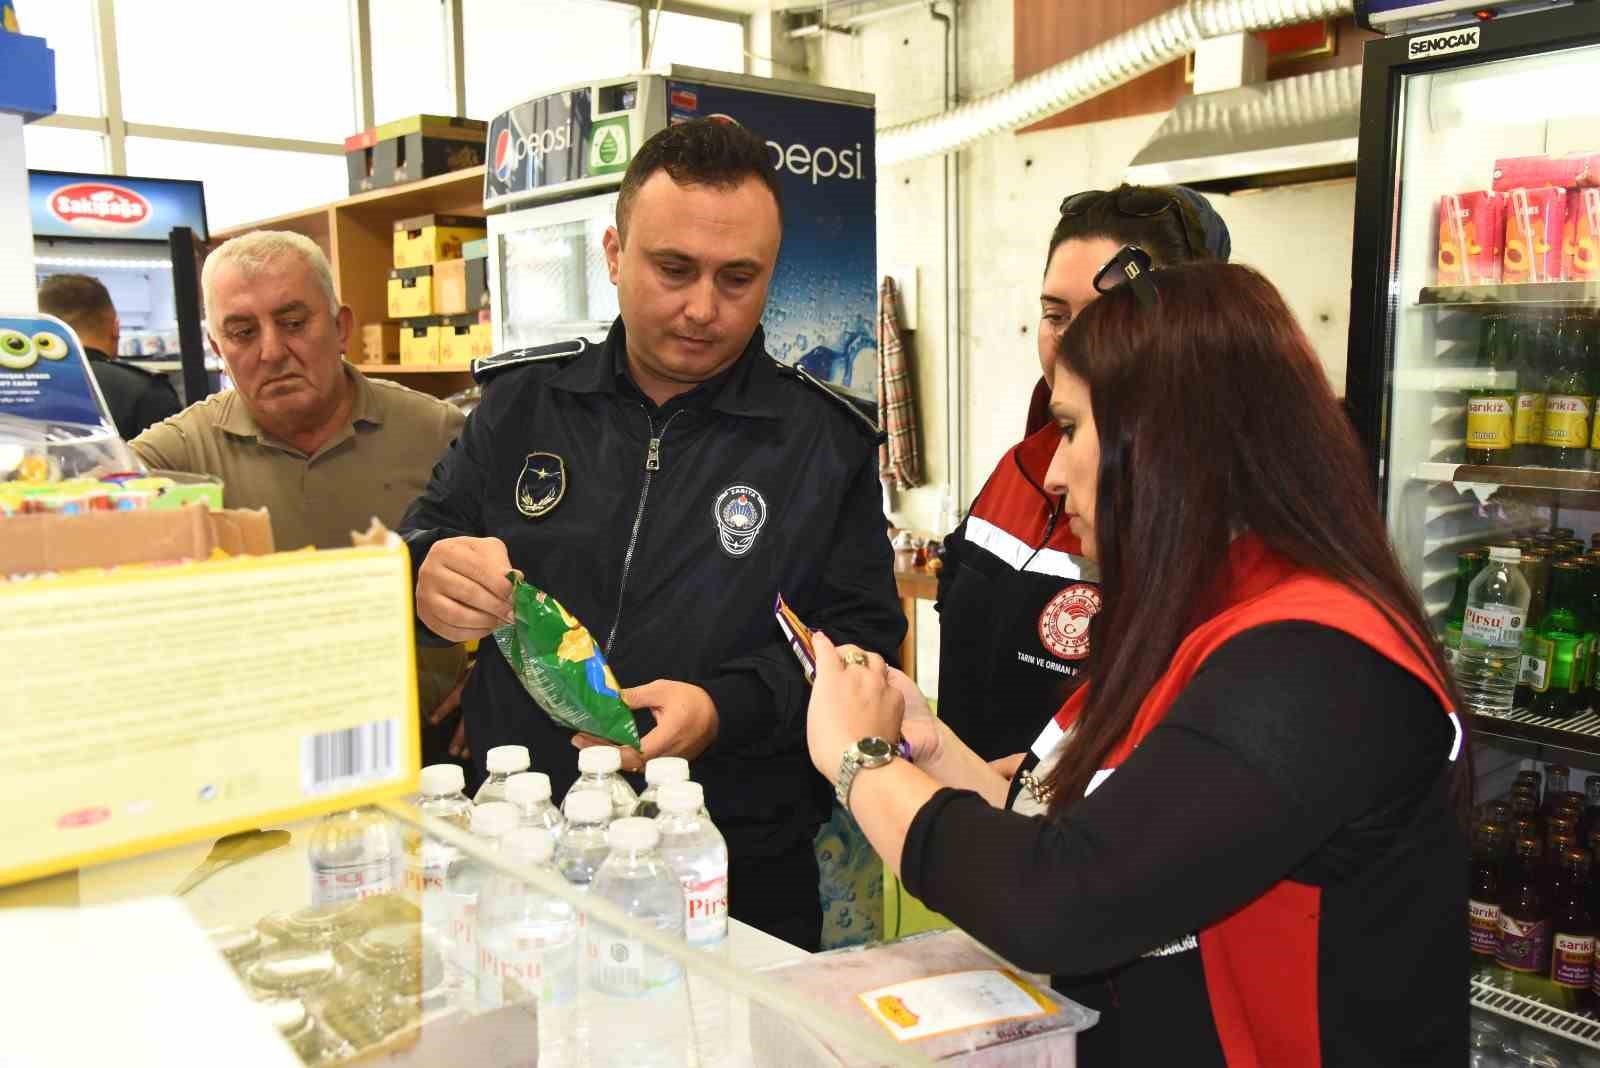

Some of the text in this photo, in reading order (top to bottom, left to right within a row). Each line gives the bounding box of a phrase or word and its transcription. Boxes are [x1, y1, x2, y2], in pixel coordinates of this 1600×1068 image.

[514, 118, 572, 171] pepsi
[1017, 651, 1036, 665] TARIM
[1036, 657, 1045, 668] VE
[1045, 660, 1071, 675] ORMAN
